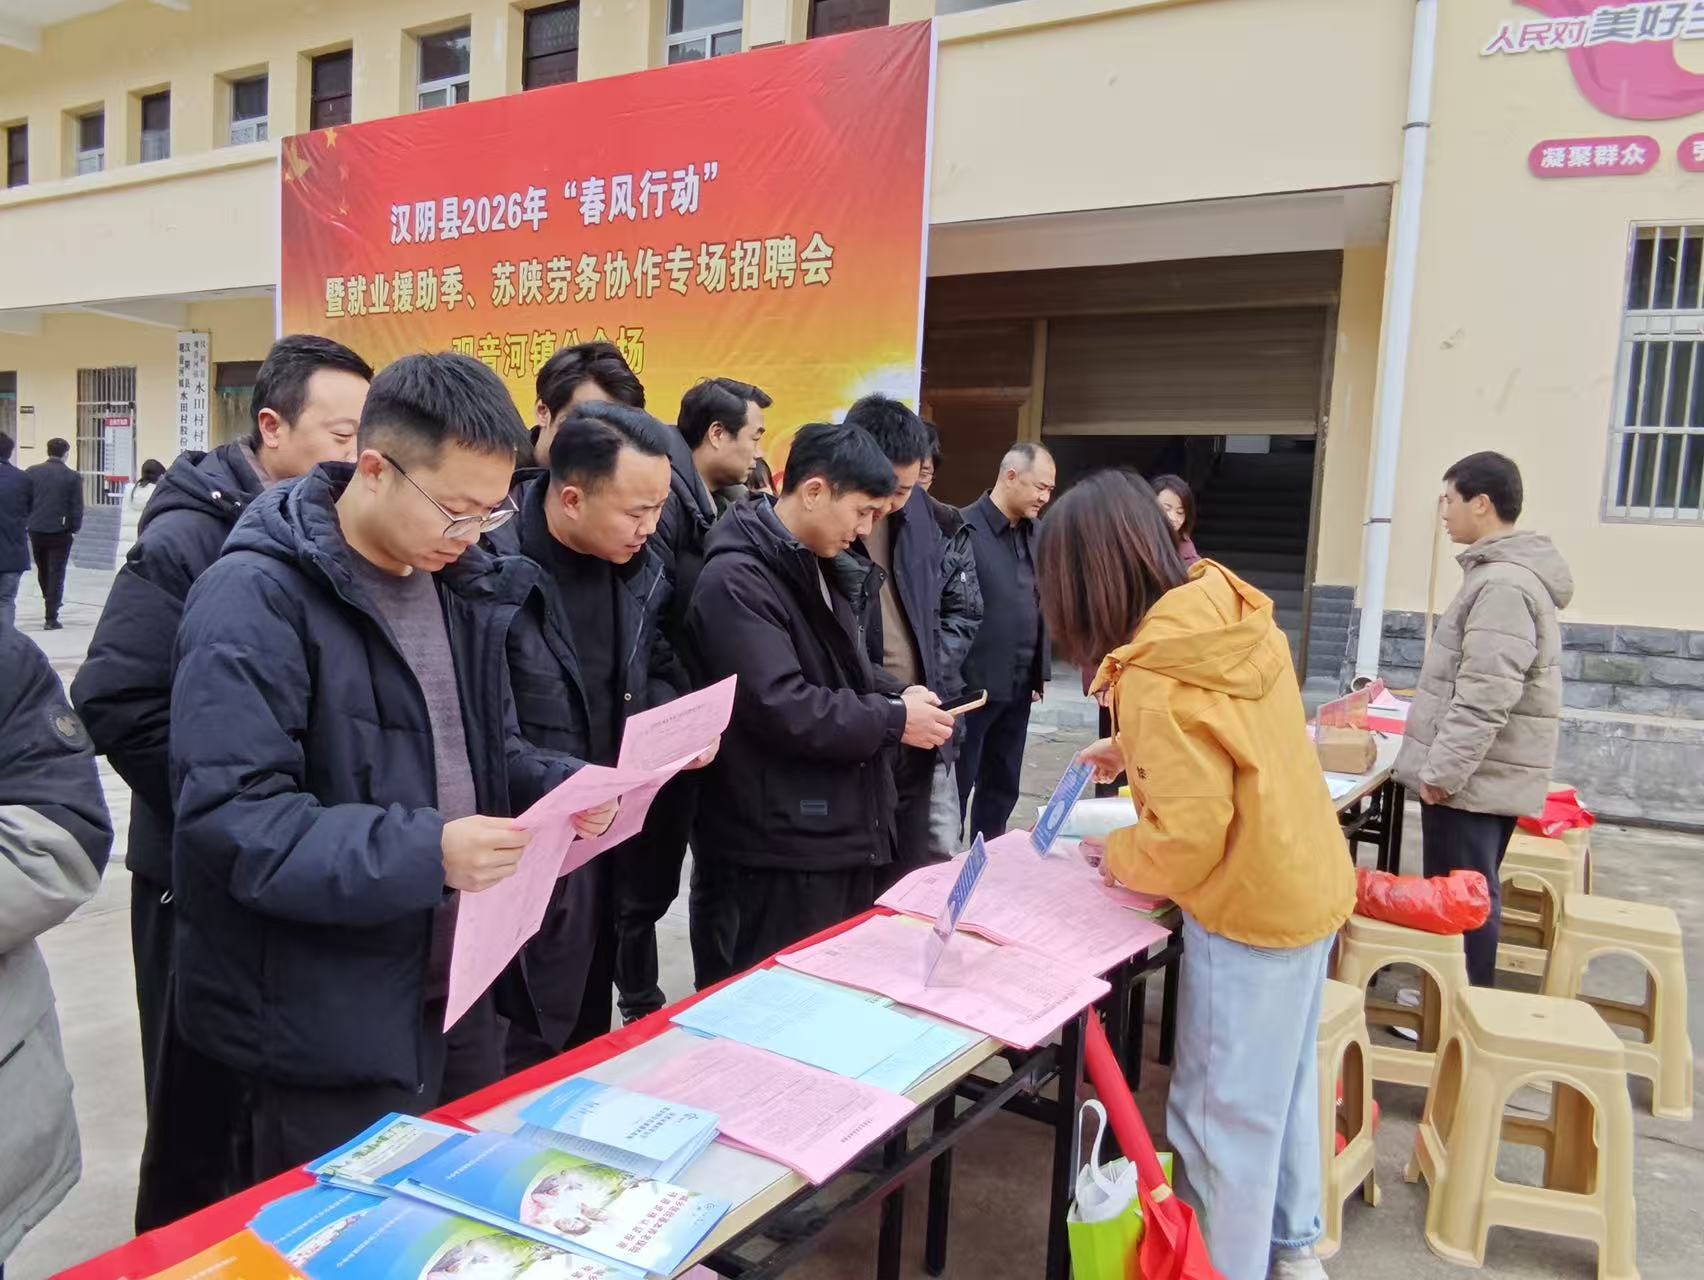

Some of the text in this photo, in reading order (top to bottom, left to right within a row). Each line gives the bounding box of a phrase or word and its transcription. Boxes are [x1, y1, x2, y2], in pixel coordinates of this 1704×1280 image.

[1540, 143, 1646, 168] 凝聚群众
[325, 232, 834, 318] 暨就业援助季、苏陕劳务协作专场招聘会
[193, 381, 206, 452] 水田村村
